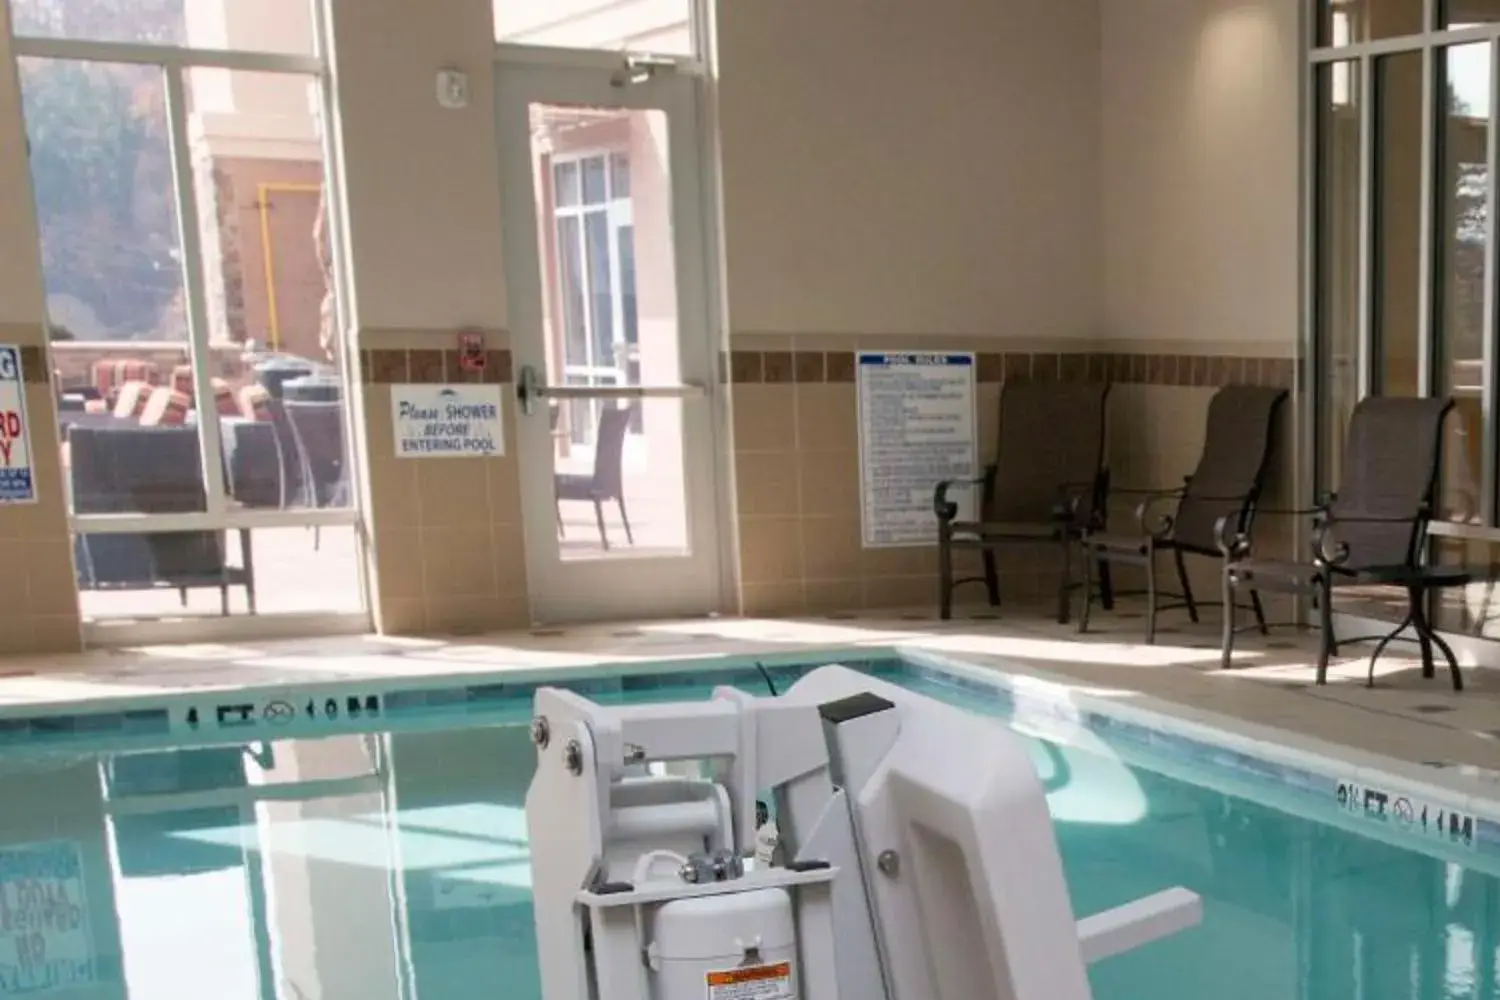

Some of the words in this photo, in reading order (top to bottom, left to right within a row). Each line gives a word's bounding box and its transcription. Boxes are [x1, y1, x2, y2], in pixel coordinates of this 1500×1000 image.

[445, 404, 496, 421] SHOWER
[424, 423, 470, 436] BEFORE
[402, 438, 461, 452] ENTERING
[463, 437, 497, 451] POOL
